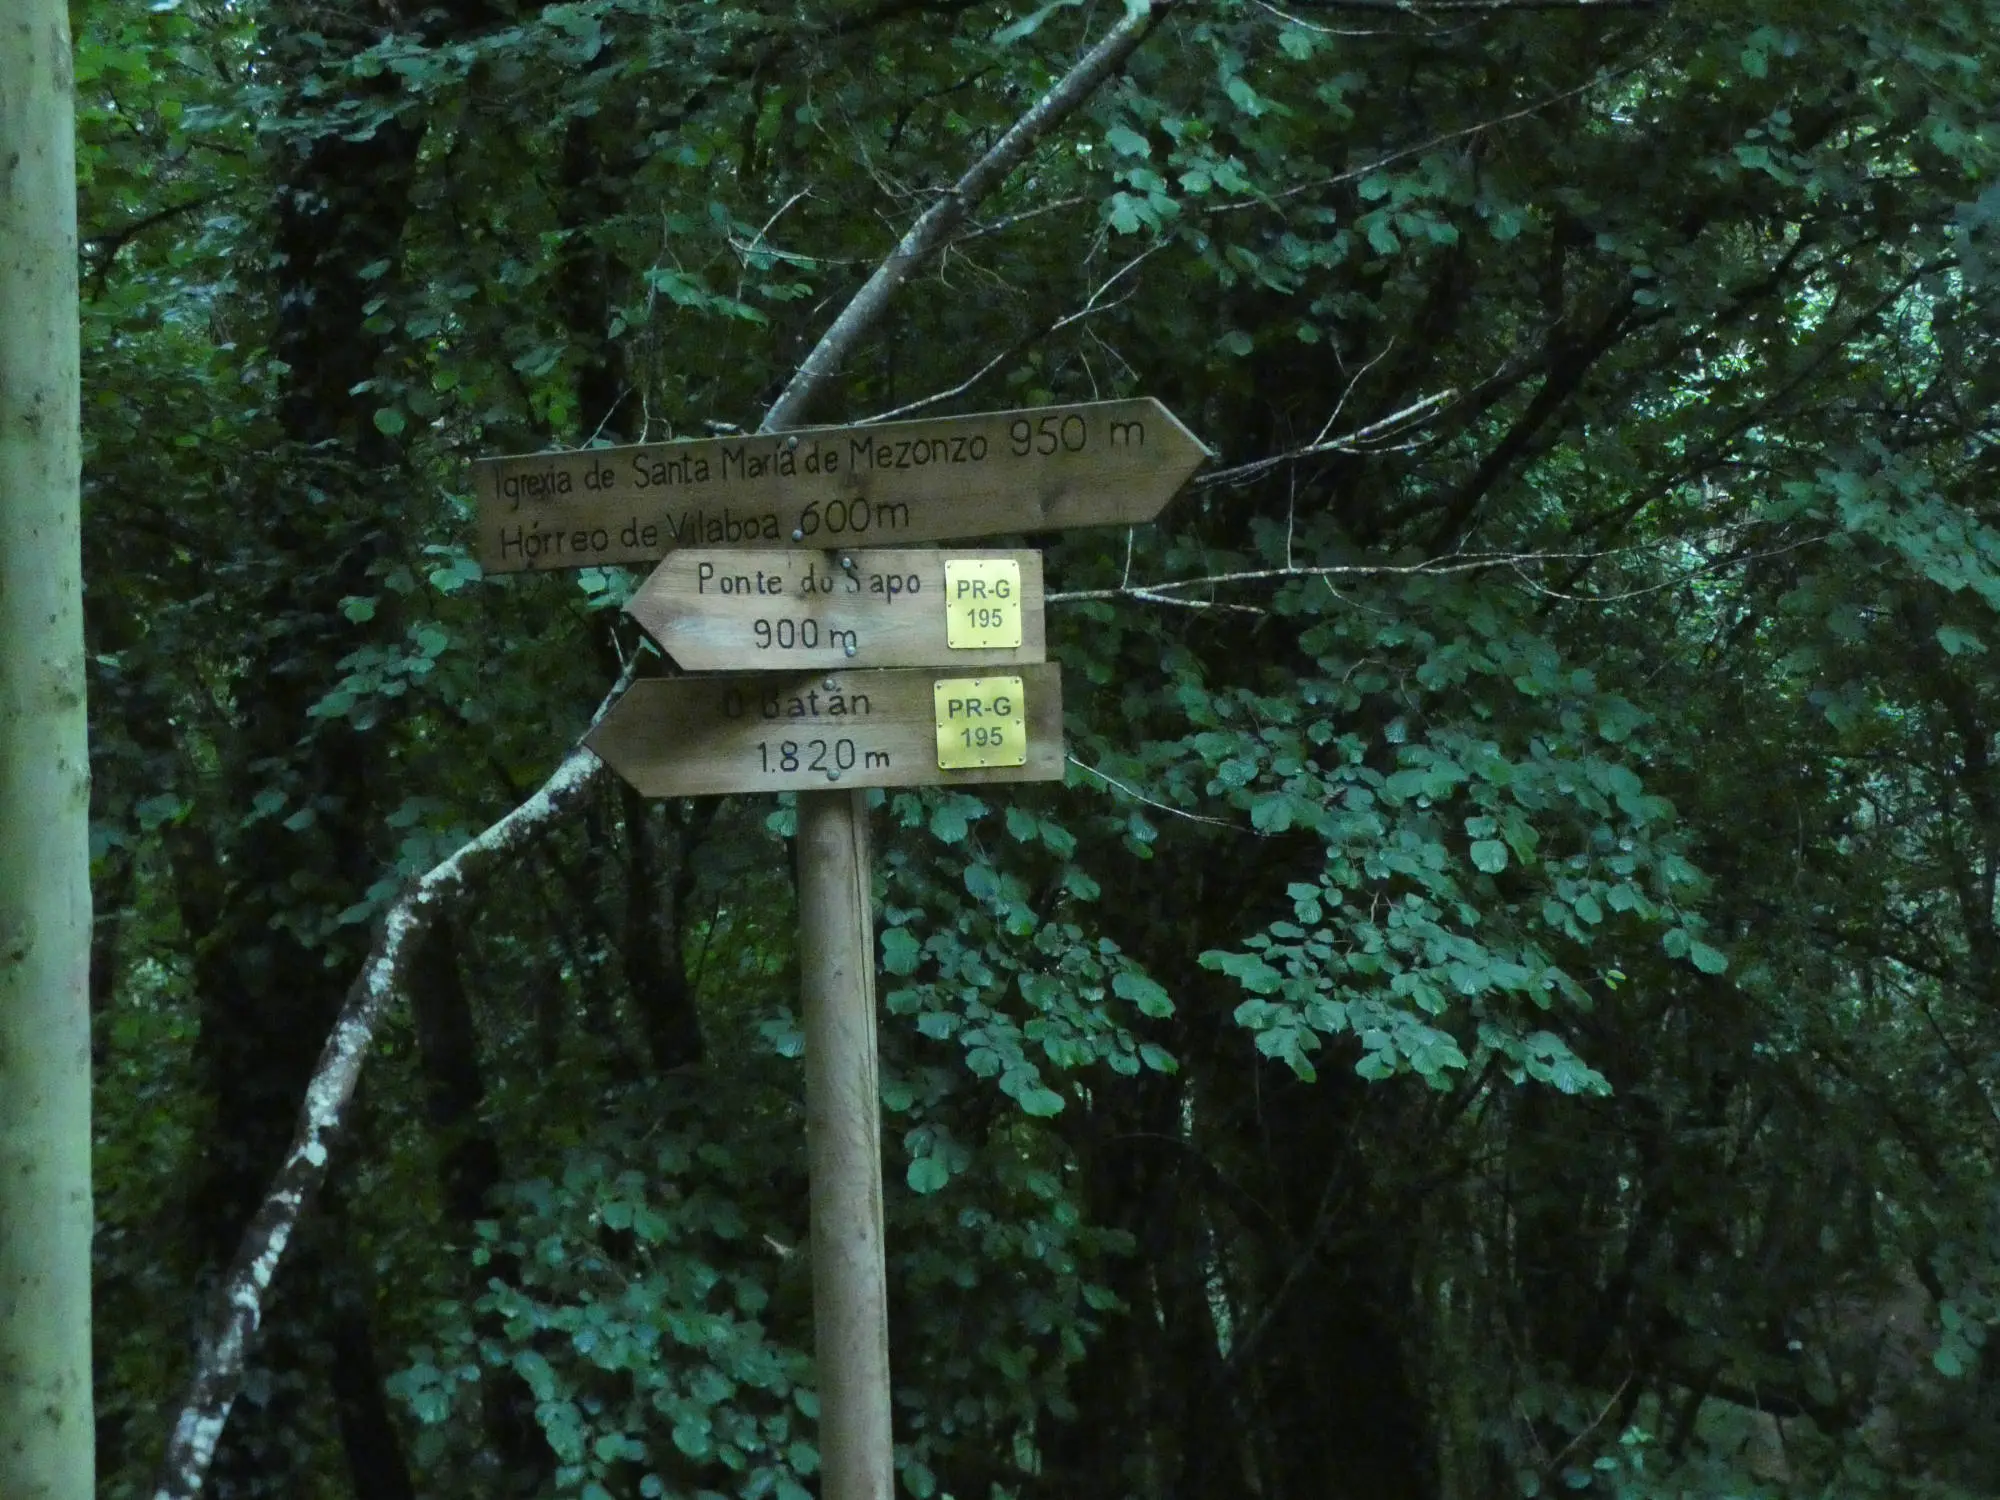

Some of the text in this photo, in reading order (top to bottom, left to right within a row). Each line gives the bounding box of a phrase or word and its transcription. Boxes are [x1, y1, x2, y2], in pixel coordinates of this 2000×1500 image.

[495, 413, 1145, 511] Igrexia de Santa María de Mezonzo 950 m
[500, 519, 609, 560] Hórreo
[620, 516, 658, 549] de
[666, 508, 780, 546] Vilaboa
[699, 561, 920, 604] Ponte do Sapo
[957, 578, 1011, 600] PR-G
[966, 608, 1003, 628] 195
[753, 619, 857, 652] 900 m
[948, 697, 1012, 719] PR-G
[960, 726, 1004, 748] 195
[757, 738, 890, 773] 1.820 m
